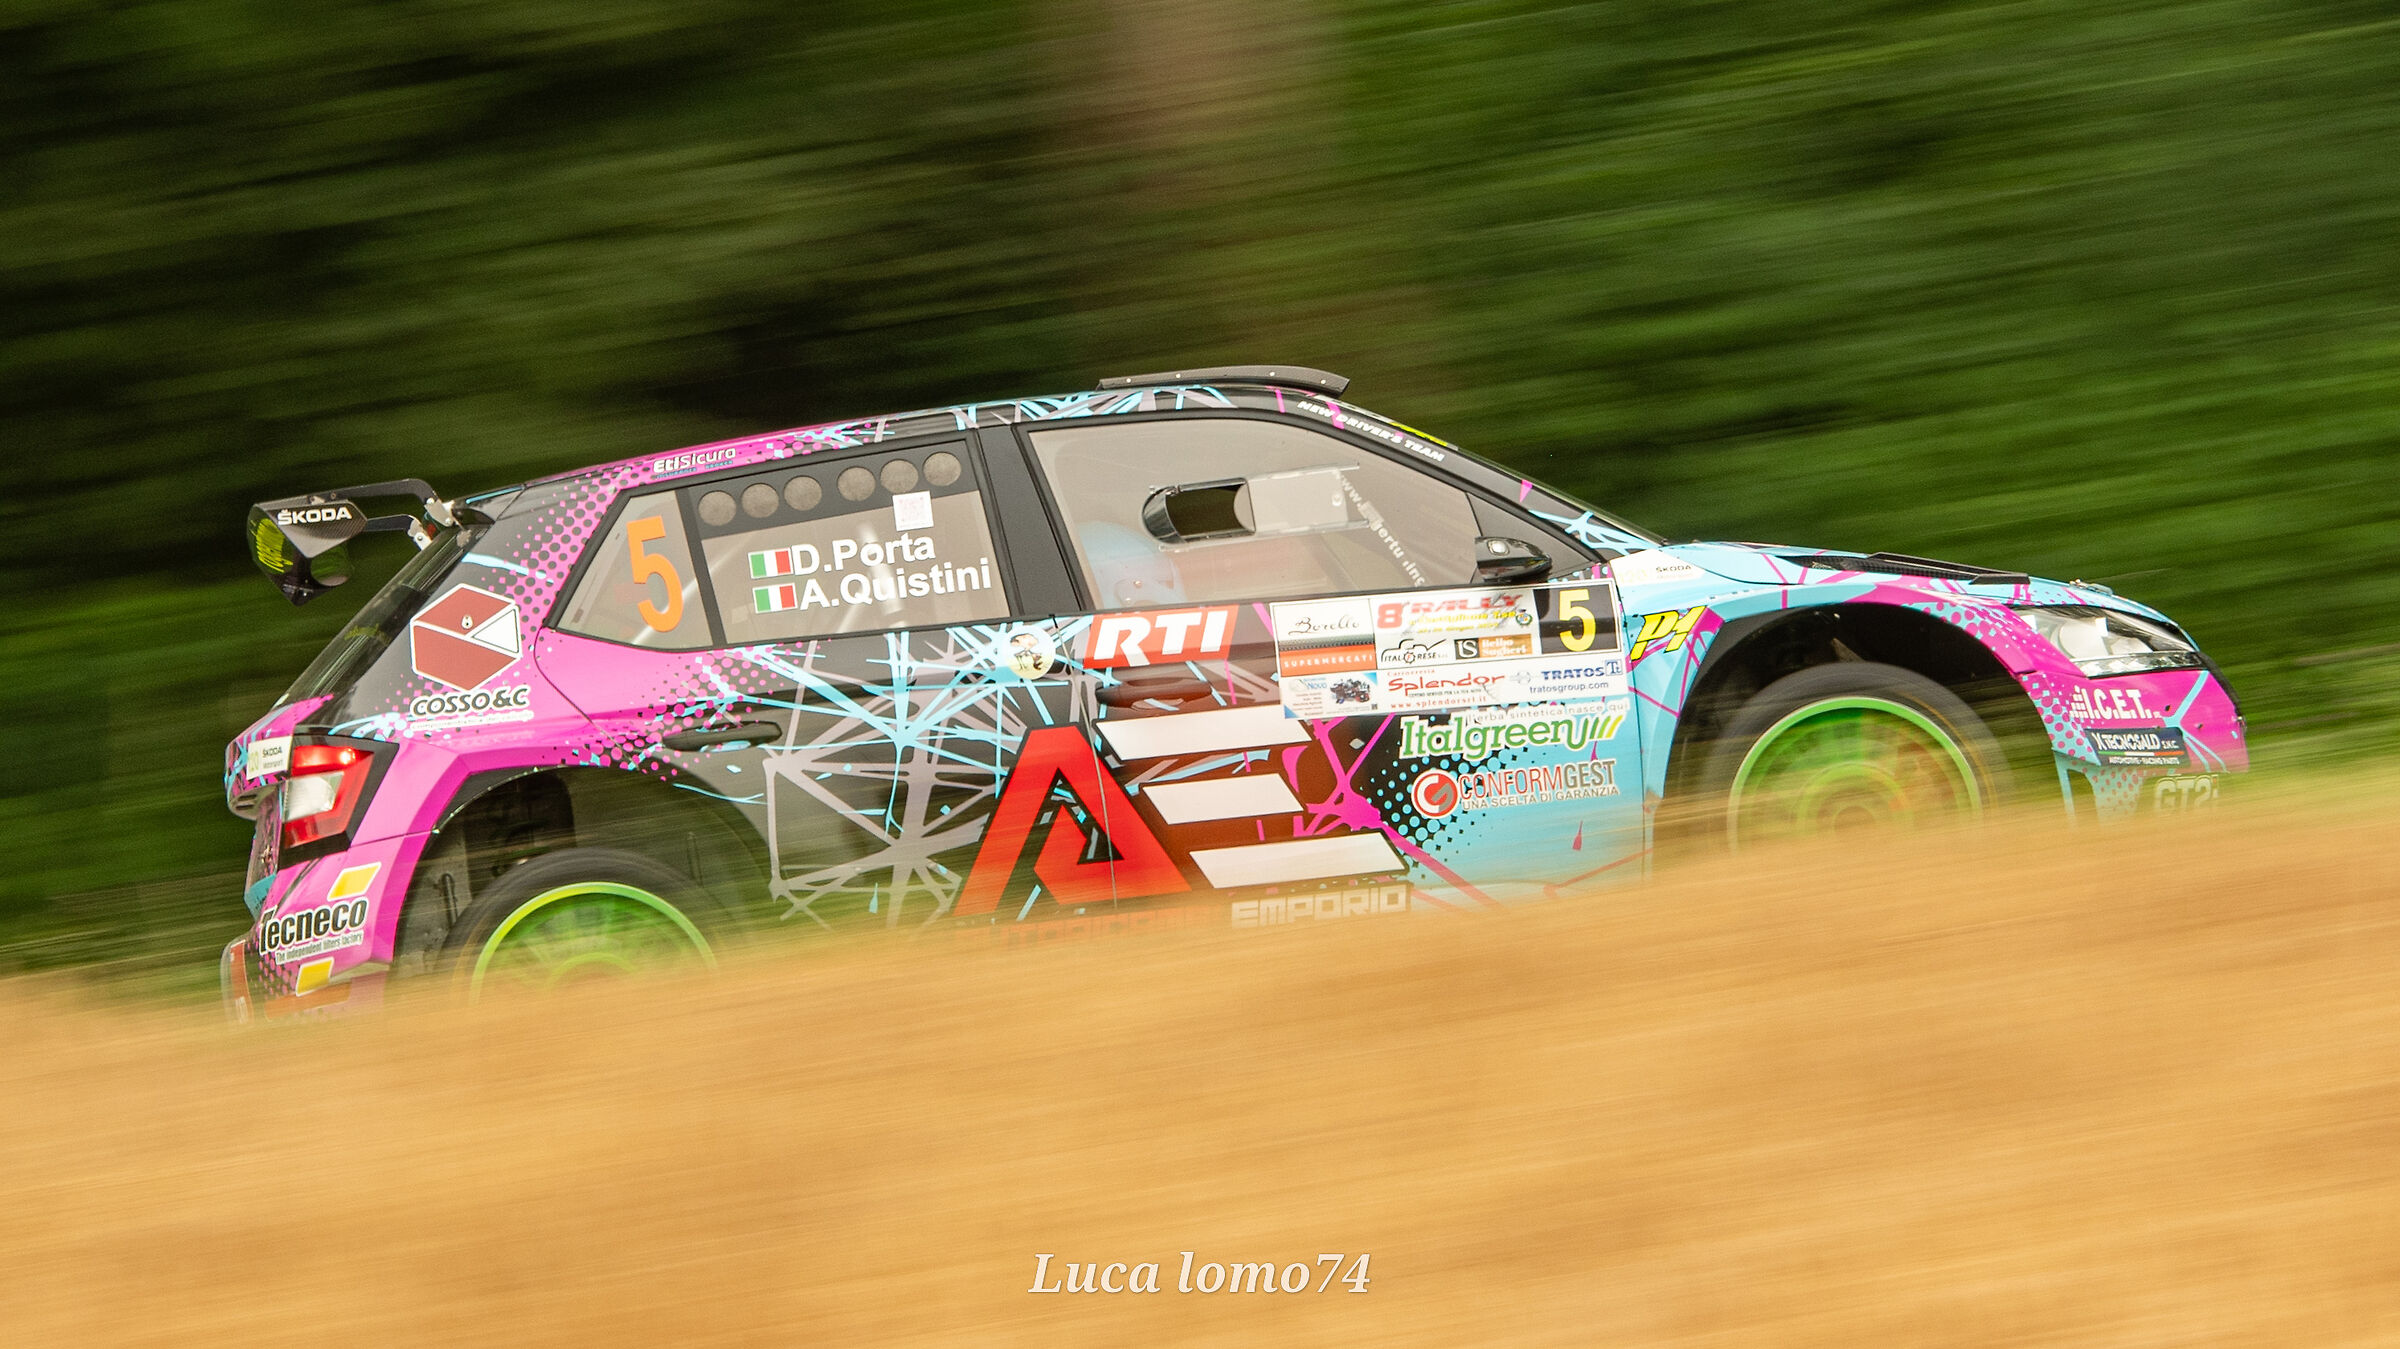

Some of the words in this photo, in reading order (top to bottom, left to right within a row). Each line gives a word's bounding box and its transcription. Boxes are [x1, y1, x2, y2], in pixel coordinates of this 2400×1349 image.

[1297, 401, 1335, 417] NEW
[1336, 414, 1403, 444] DRIVER'S
[1404, 439, 1445, 462] TEAM
[277, 508, 353, 526] ŠKODA
[626, 515, 684, 632] 5
[791, 533, 936, 576] D.Porta
[800, 557, 992, 611] A.Quistini
[1411, 595, 1523, 614] RALLY
[1558, 589, 1597, 651] 5
[1093, 611, 1229, 667] RTI
[1284, 654, 1373, 668] SUPERMERCATI
[1541, 667, 1605, 680] TRATOS
[413, 688, 528, 716] COSSO&C
[1388, 672, 1505, 696] Splendor
[1529, 681, 1609, 694] tratosgroup.com
[1510, 706, 1563, 719] sintetica
[1568, 704, 1603, 714] nasce
[1609, 702, 1628, 712] qui
[1403, 716, 1588, 760] Italgreen
[1460, 760, 1616, 800] CONFORMGEST
[1462, 797, 1488, 811] UNA
[1490, 793, 1538, 807] SCELTA
[1540, 792, 1552, 803] DI
[1555, 787, 1619, 802] GARANZIA
[260, 900, 368, 953] Tecneco
[1231, 885, 1407, 929] EMPORIO
